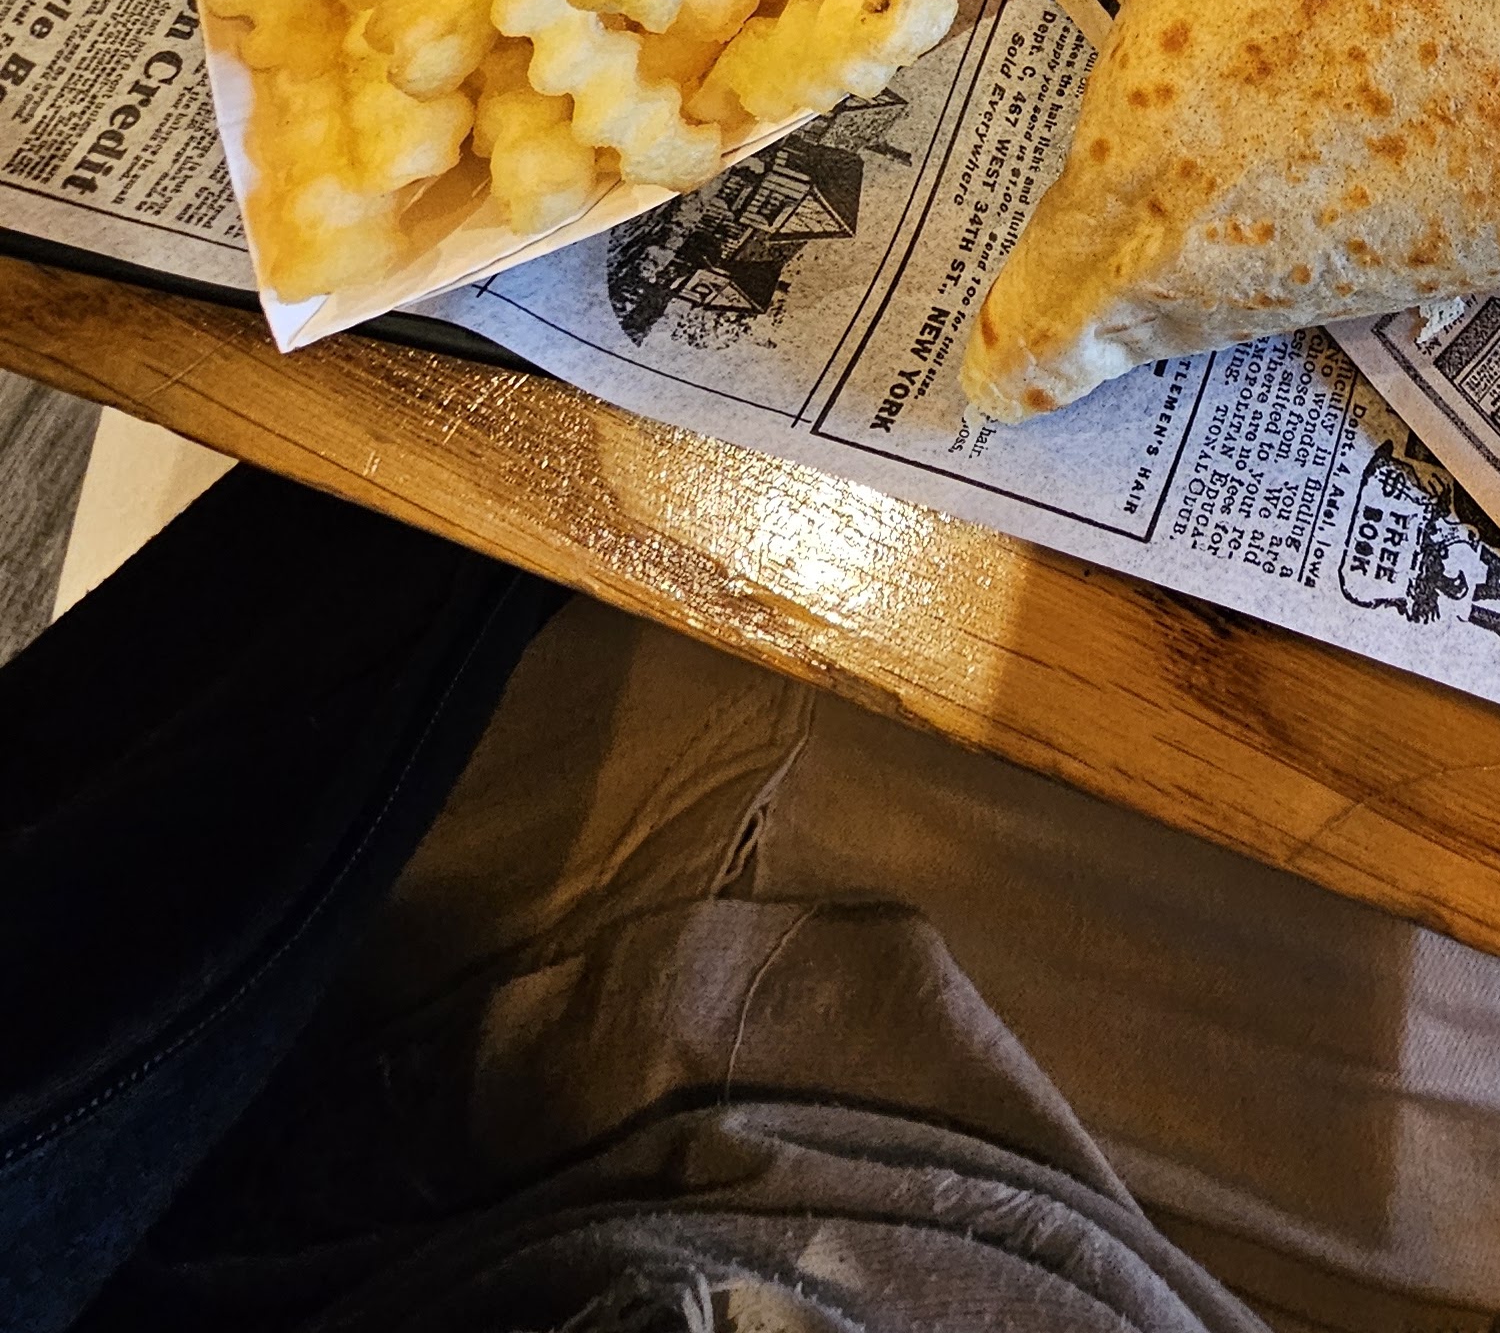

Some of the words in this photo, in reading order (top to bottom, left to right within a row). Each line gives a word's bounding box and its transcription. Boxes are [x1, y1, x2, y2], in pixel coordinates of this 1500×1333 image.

[999, 31, 1025, 80] Sold
[1028, 10, 1058, 56] Dept.
[59, 50, 184, 196] Credit
[1004, 90, 1027, 128] 467
[953, 82, 1007, 206] Everywhere
[982, 139, 1012, 193] WEST
[958, 200, 989, 253] 34TH
[910, 306, 950, 363] NEW
[869, 369, 922, 434] YORK
[1263, 368, 1294, 436] suited
[1293, 392, 1327, 468] wonder
[1123, 466, 1152, 515] HAIR
[1237, 468, 1265, 519] your
[1284, 476, 1326, 553] finding
[1300, 539, 1332, 588] Iowa
[1349, 505, 1384, 577] BOOK
[1374, 510, 1414, 584] FREE
